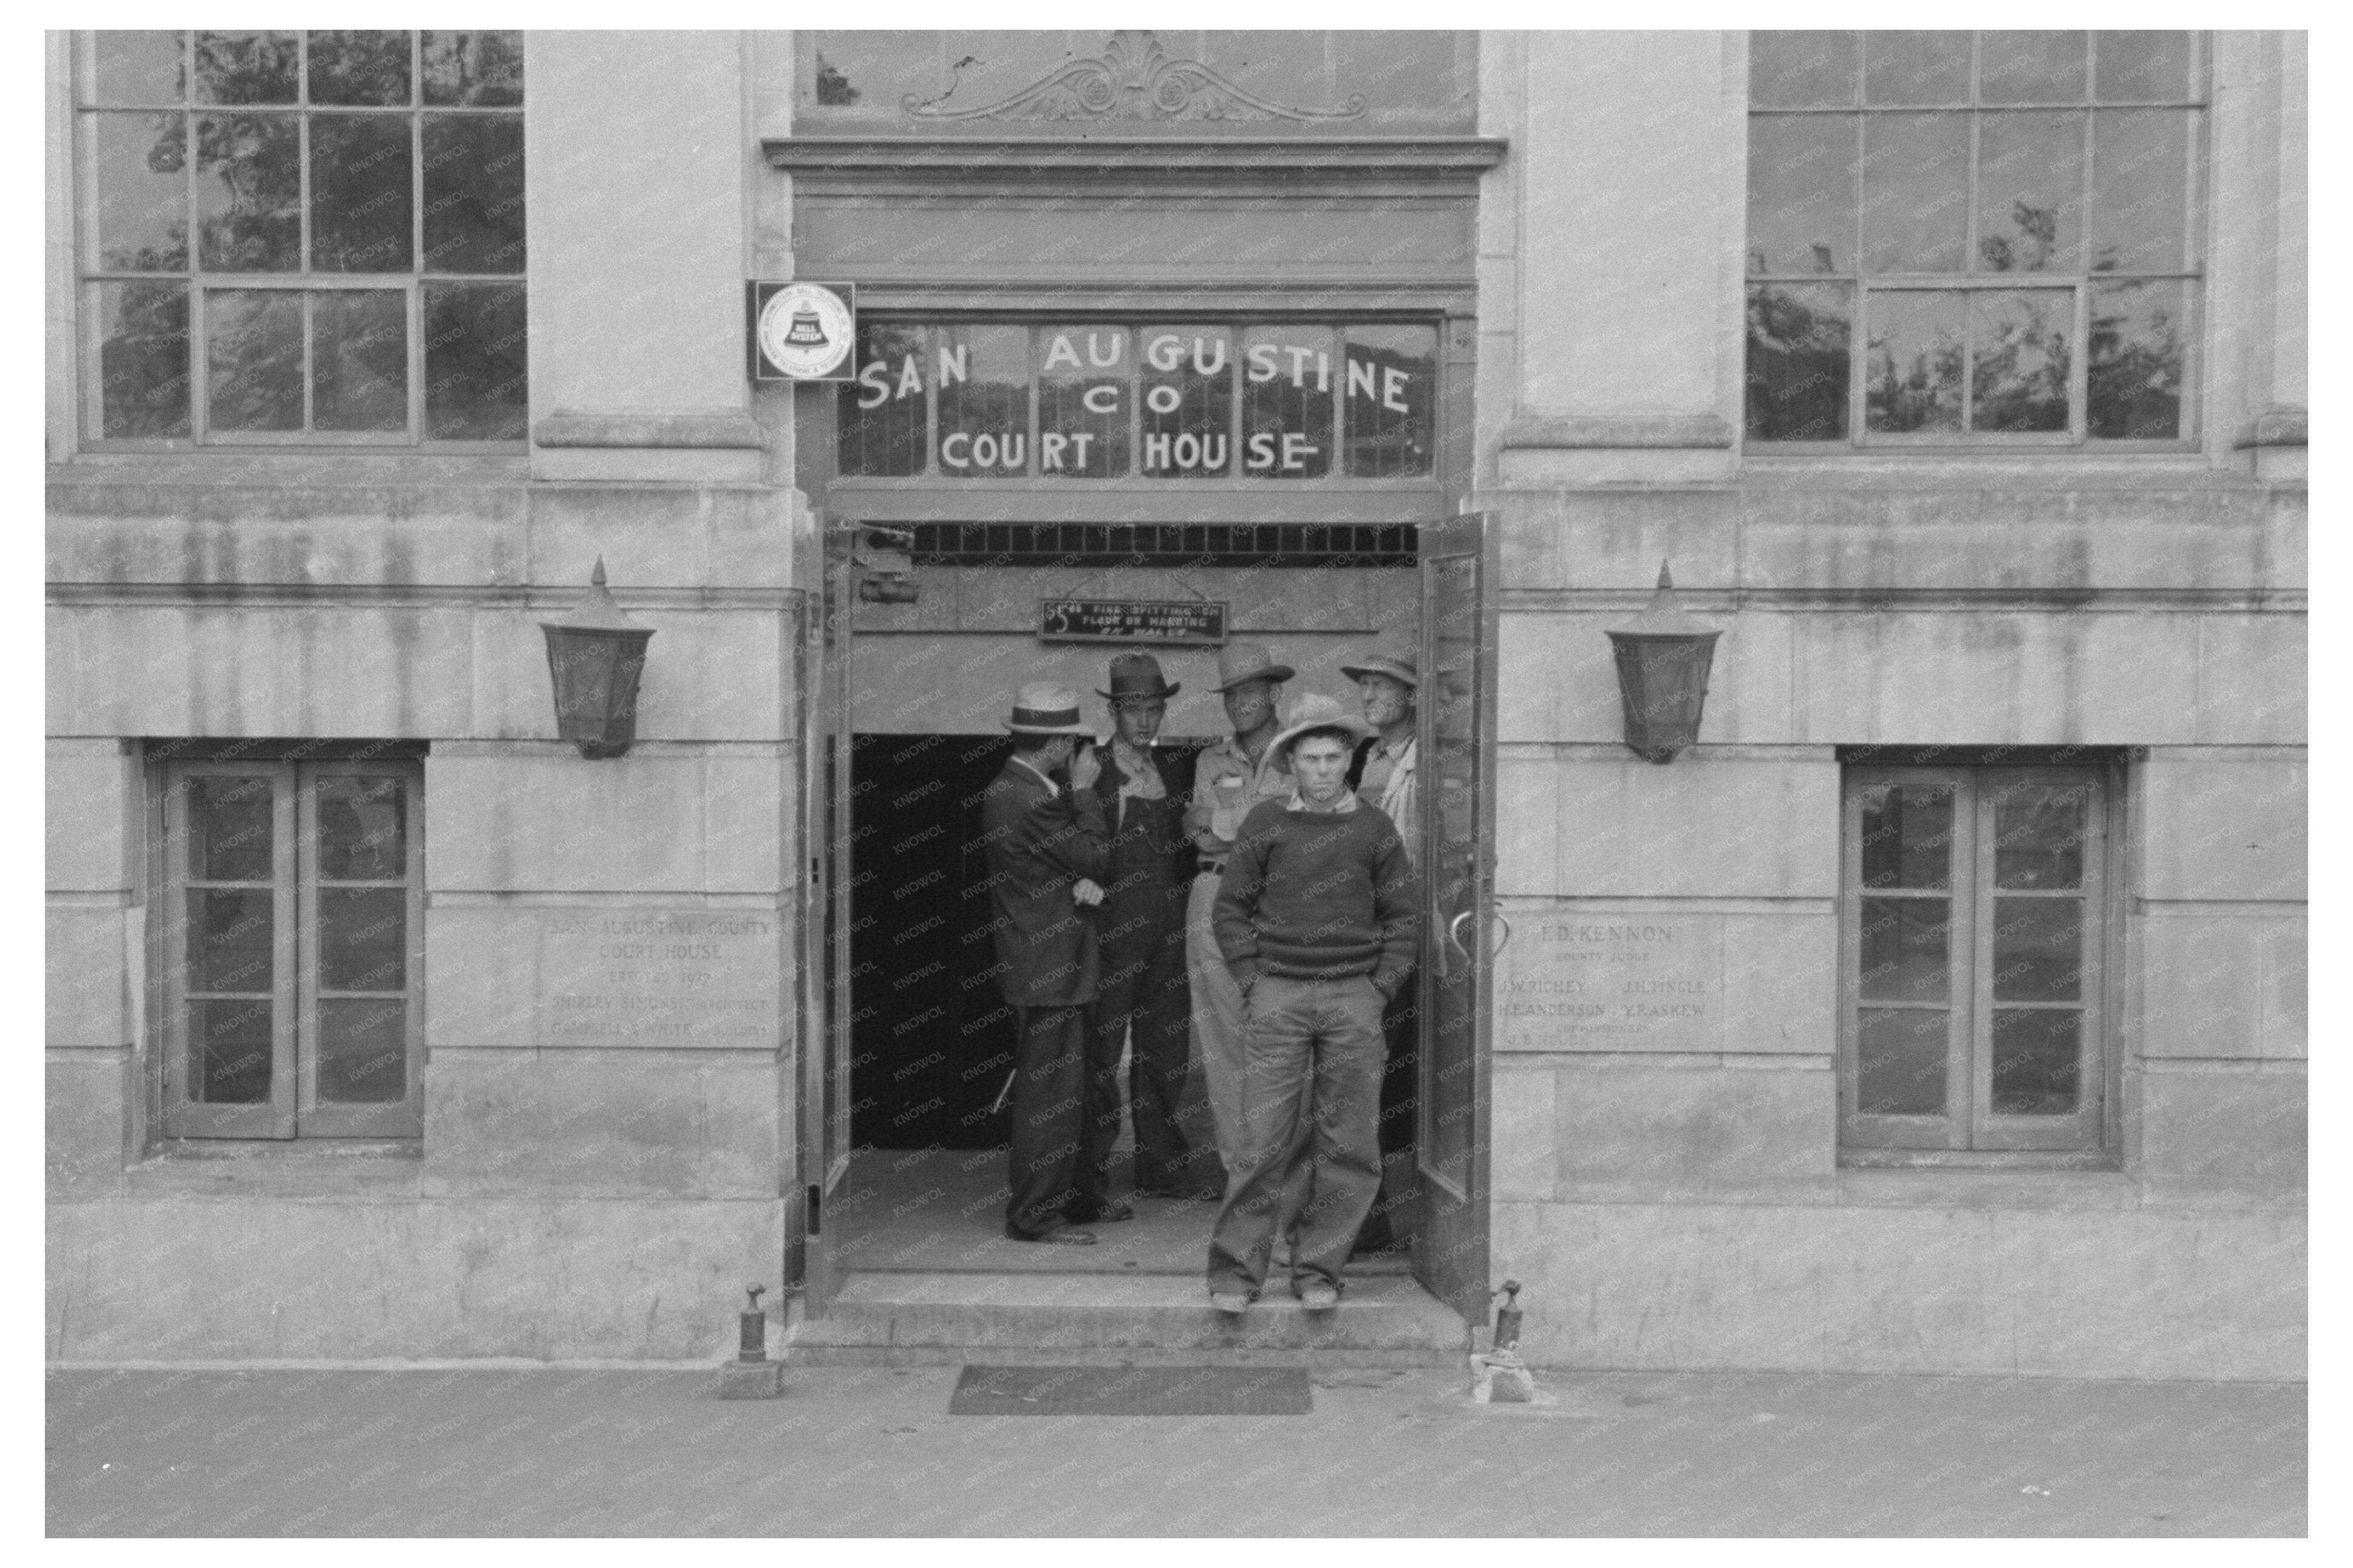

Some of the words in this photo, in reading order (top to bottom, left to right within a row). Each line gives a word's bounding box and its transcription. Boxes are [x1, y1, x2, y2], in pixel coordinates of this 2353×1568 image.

[796, 324, 817, 332] BELL
[791, 332, 822, 341] SYSTEM
[858, 344, 965, 409] SAN
[1044, 333, 1409, 414] AUGUSTINE
[942, 432, 1094, 468] COURT
[1146, 432, 1319, 469] HOUSE
[601, 921, 697, 935] AUGUSTINE
[709, 921, 771, 935] COUNTY
[1580, 925, 1672, 942] KENNON
[599, 944, 655, 959] COURT
[666, 944, 722, 960] HOUSE
